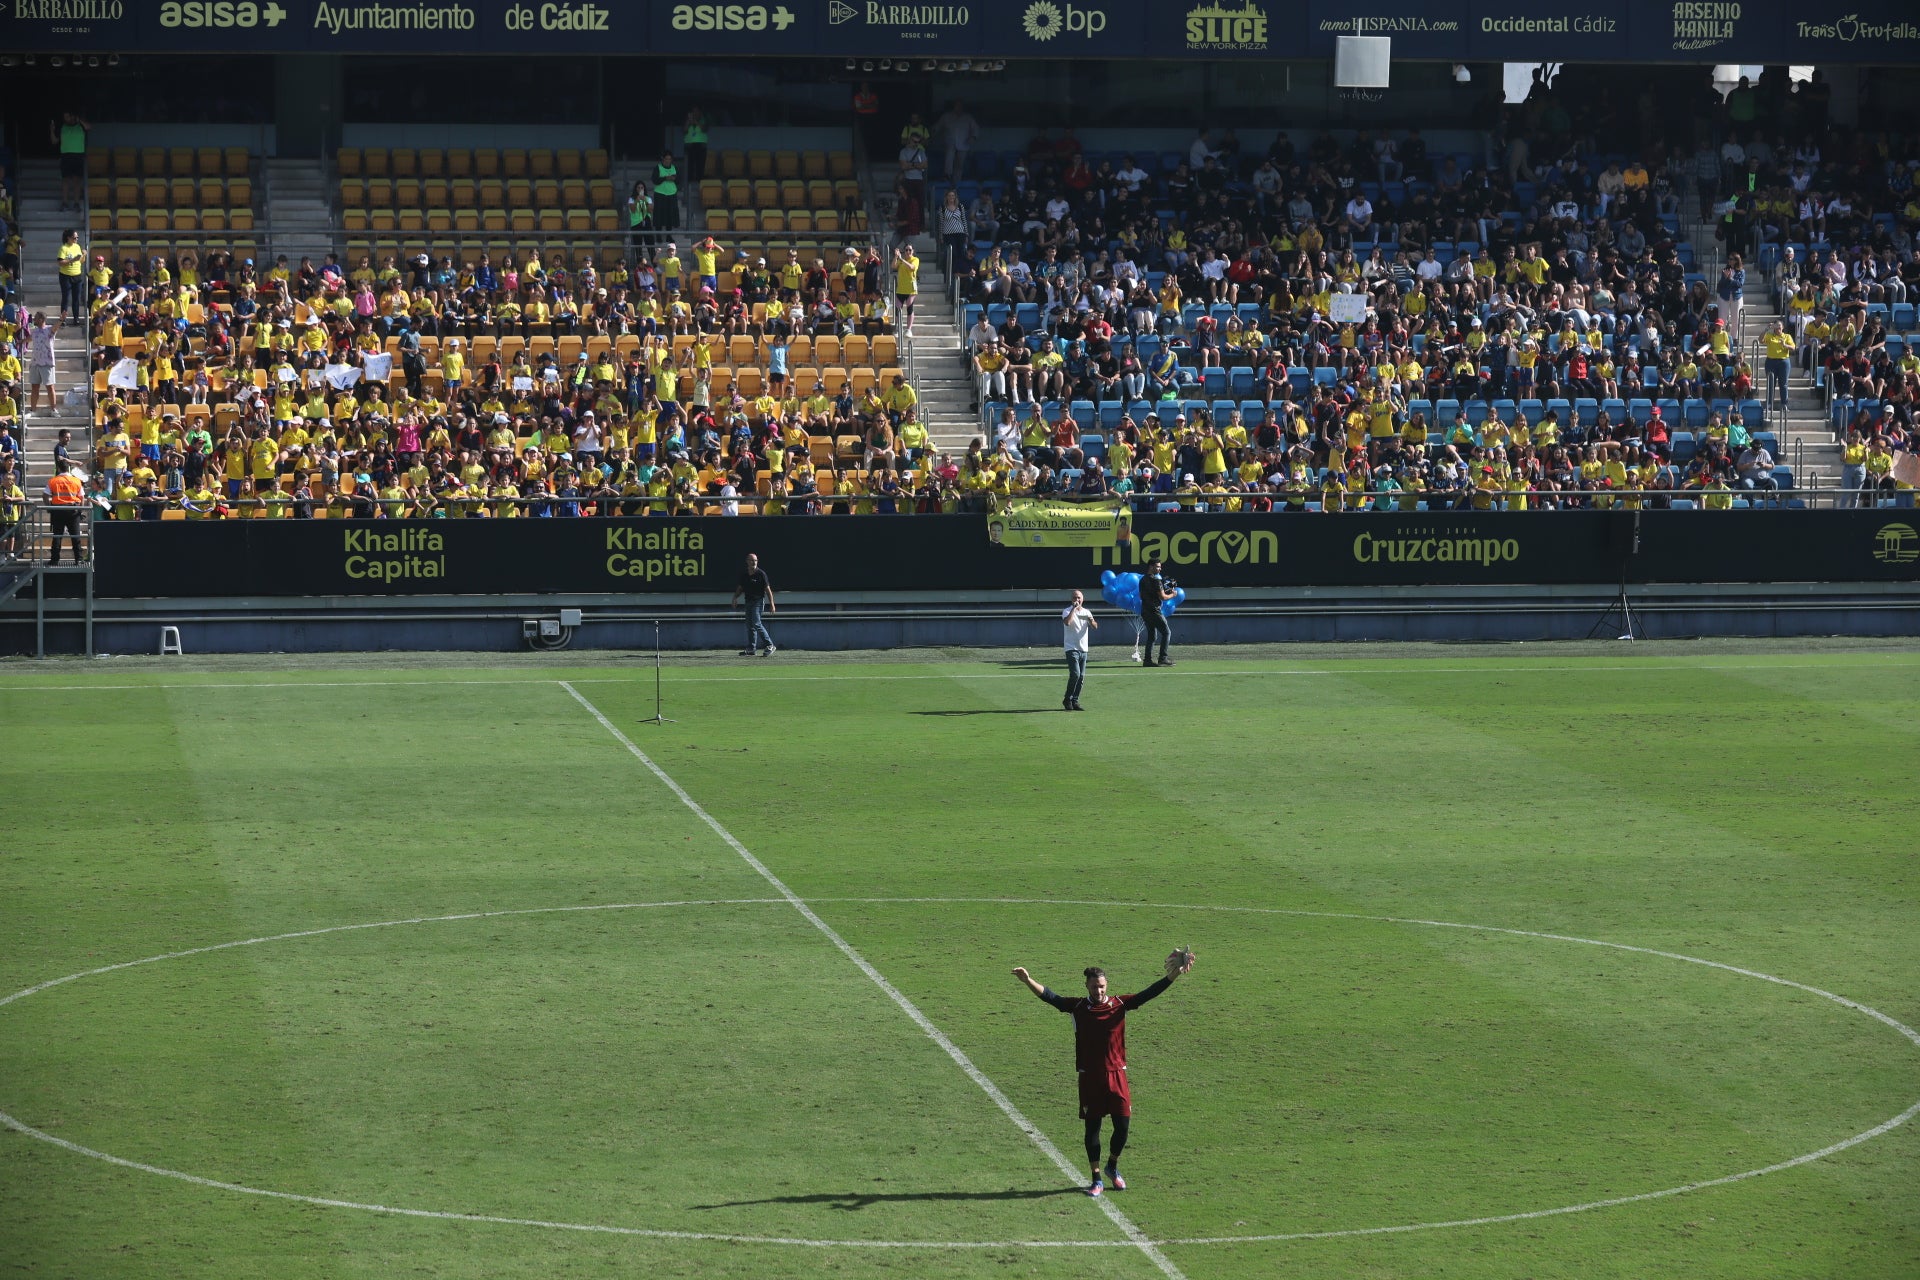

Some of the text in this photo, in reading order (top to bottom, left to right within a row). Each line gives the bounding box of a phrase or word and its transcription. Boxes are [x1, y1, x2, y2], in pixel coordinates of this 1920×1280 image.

[15, 0, 124, 20] BARBADILLO
[160, 2, 259, 28] asisa
[314, 2, 610, 35] Ayuntamiento de Cádiz
[672, 5, 768, 31] asisa
[866, 1, 969, 26] BARBADILLO
[1066, 4, 1107, 39] bp
[1673, 2, 1742, 20] ARSENIO
[1186, 17, 1268, 43] SLICE
[1481, 15, 1616, 33] Occidental Cádiz
[1673, 20, 1735, 38] MANILA
[1186, 42, 1267, 50] NEW YORK PIZZA
[1008, 520, 1048, 529] CADISTA
[1062, 520, 1092, 529] BOSCO
[1094, 520, 1111, 529] 2004
[344, 528, 444, 552] Khalifa
[606, 526, 704, 550] Khalifa
[1092, 530, 1279, 565] macron
[1353, 531, 1520, 567] Cruzcampo
[344, 555, 445, 584] Capital
[606, 553, 705, 582] Capital
